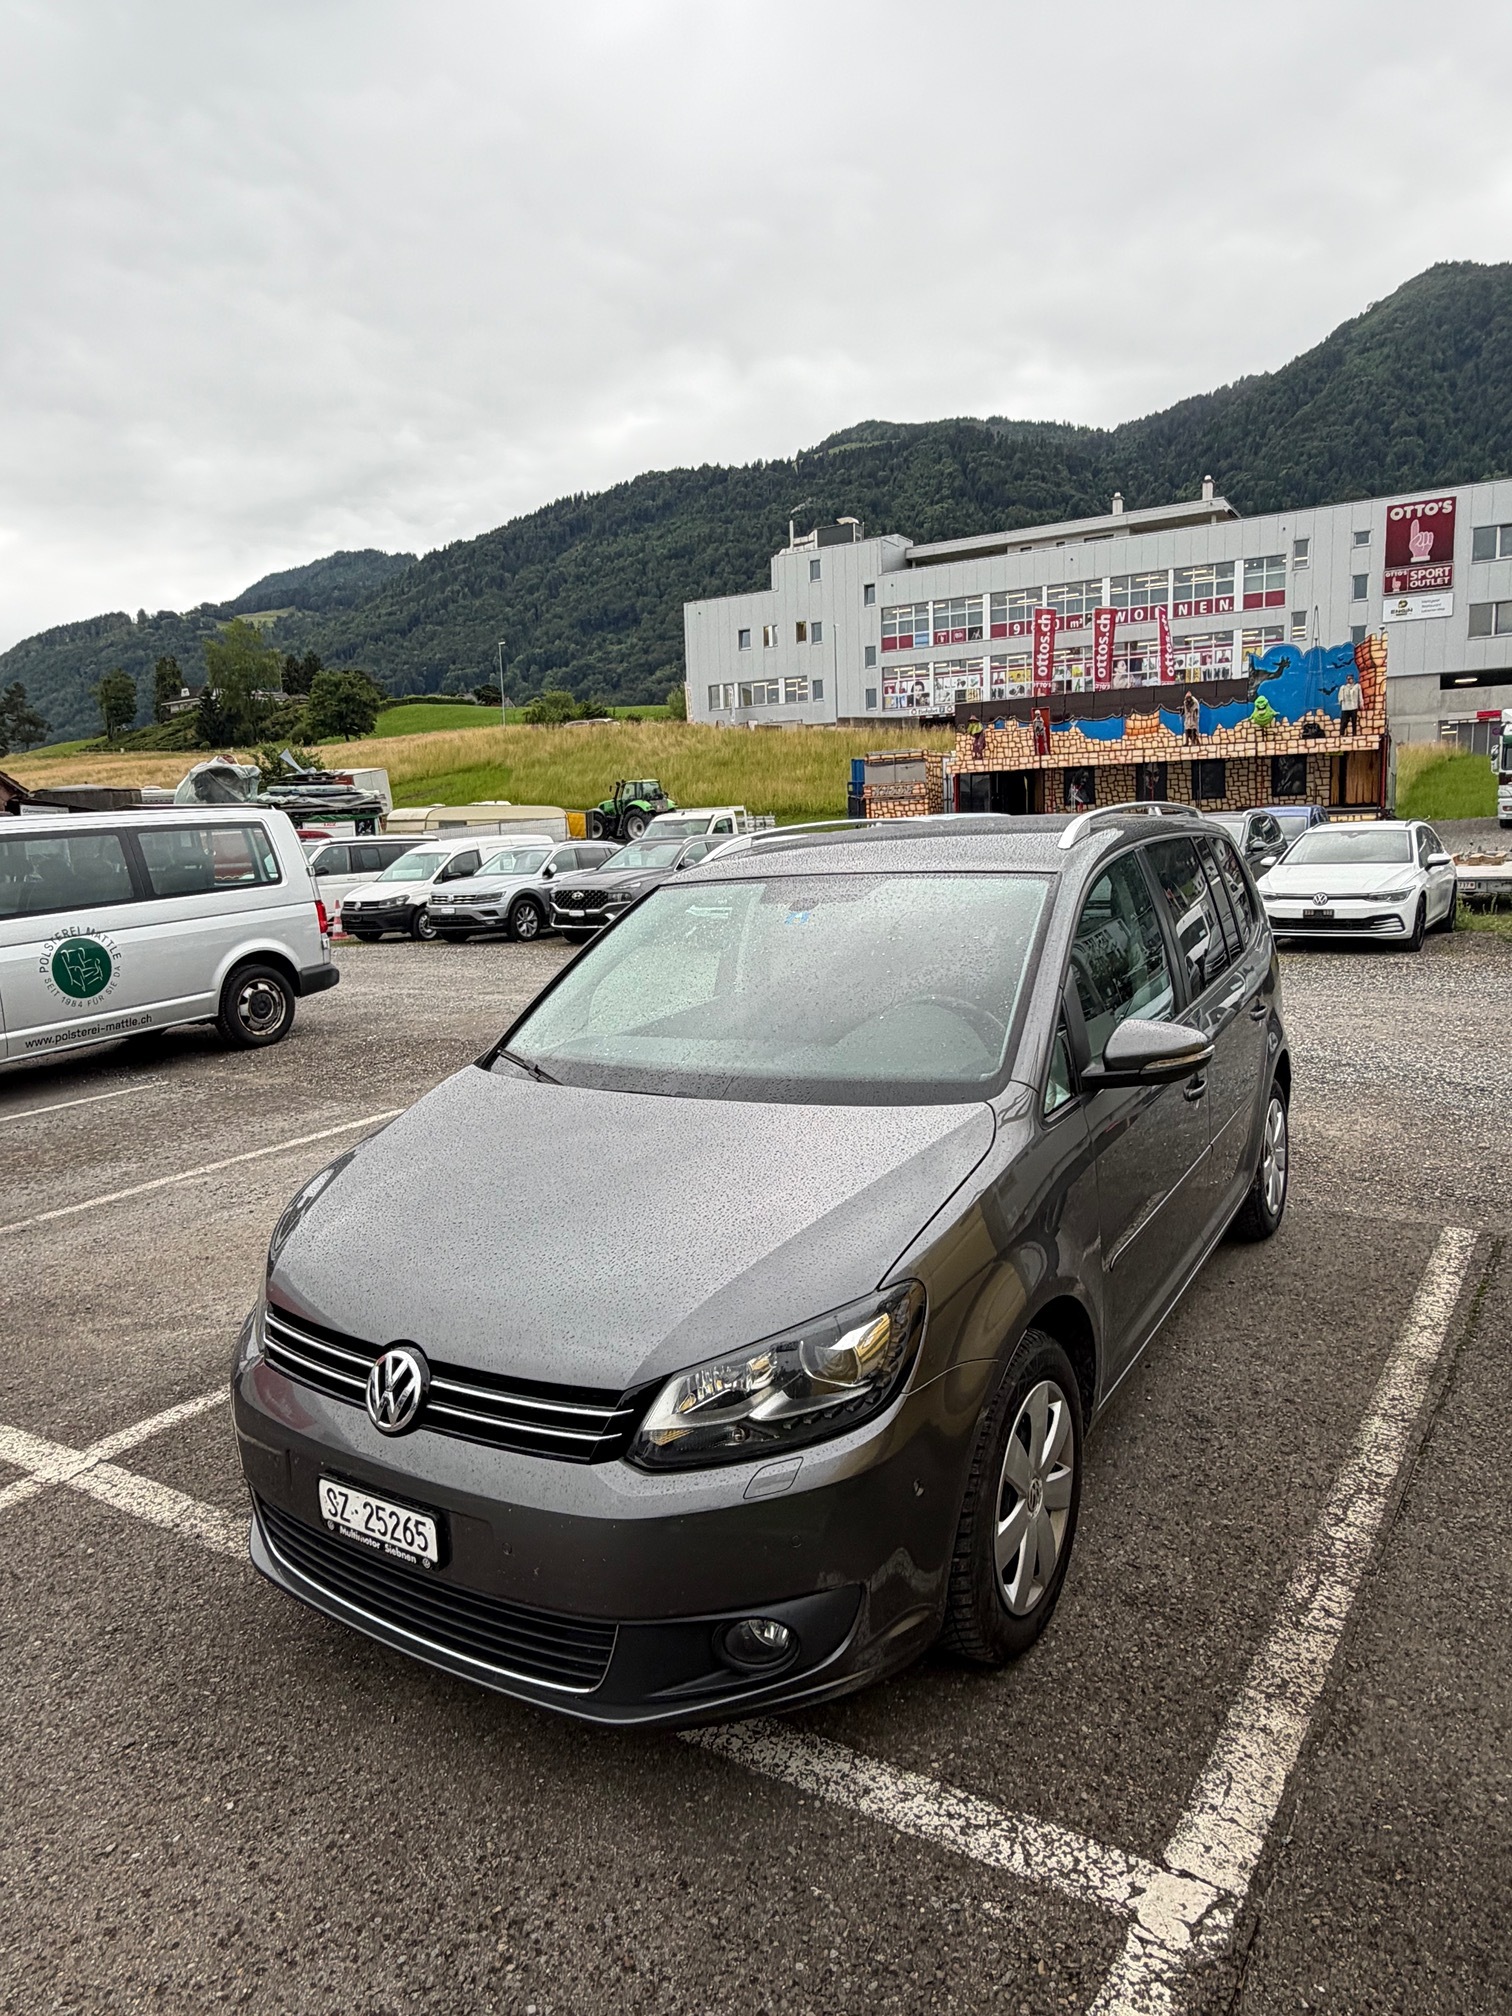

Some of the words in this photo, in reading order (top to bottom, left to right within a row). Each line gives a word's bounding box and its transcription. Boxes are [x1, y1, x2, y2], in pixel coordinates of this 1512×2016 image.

[1390, 500, 1453, 520] OTTO'S
[1410, 567, 1451, 580] SPORT
[1410, 577, 1450, 587] OUTLET
[1116, 599, 1233, 623] WONEN.
[1036, 614, 1052, 677] ottos.ch
[1096, 614, 1111, 678] ottos.ch
[39, 926, 80, 973] POLSTEREI
[86, 927, 122, 960] MATTLE
[44, 978, 60, 997] SEIT
[61, 996, 83, 1008] 1984
[87, 995, 105, 1007] FÜR
[105, 981, 118, 995] SIE
[113, 965, 121, 978] DA
[25, 1014, 153, 1048] www.polsterei-mattle.ch
[326, 1487, 351, 1523] SZ
[363, 1501, 429, 1552] 25265
[339, 1526, 381, 1549] Multimotor
[384, 1544, 417, 1564] Siebnen
